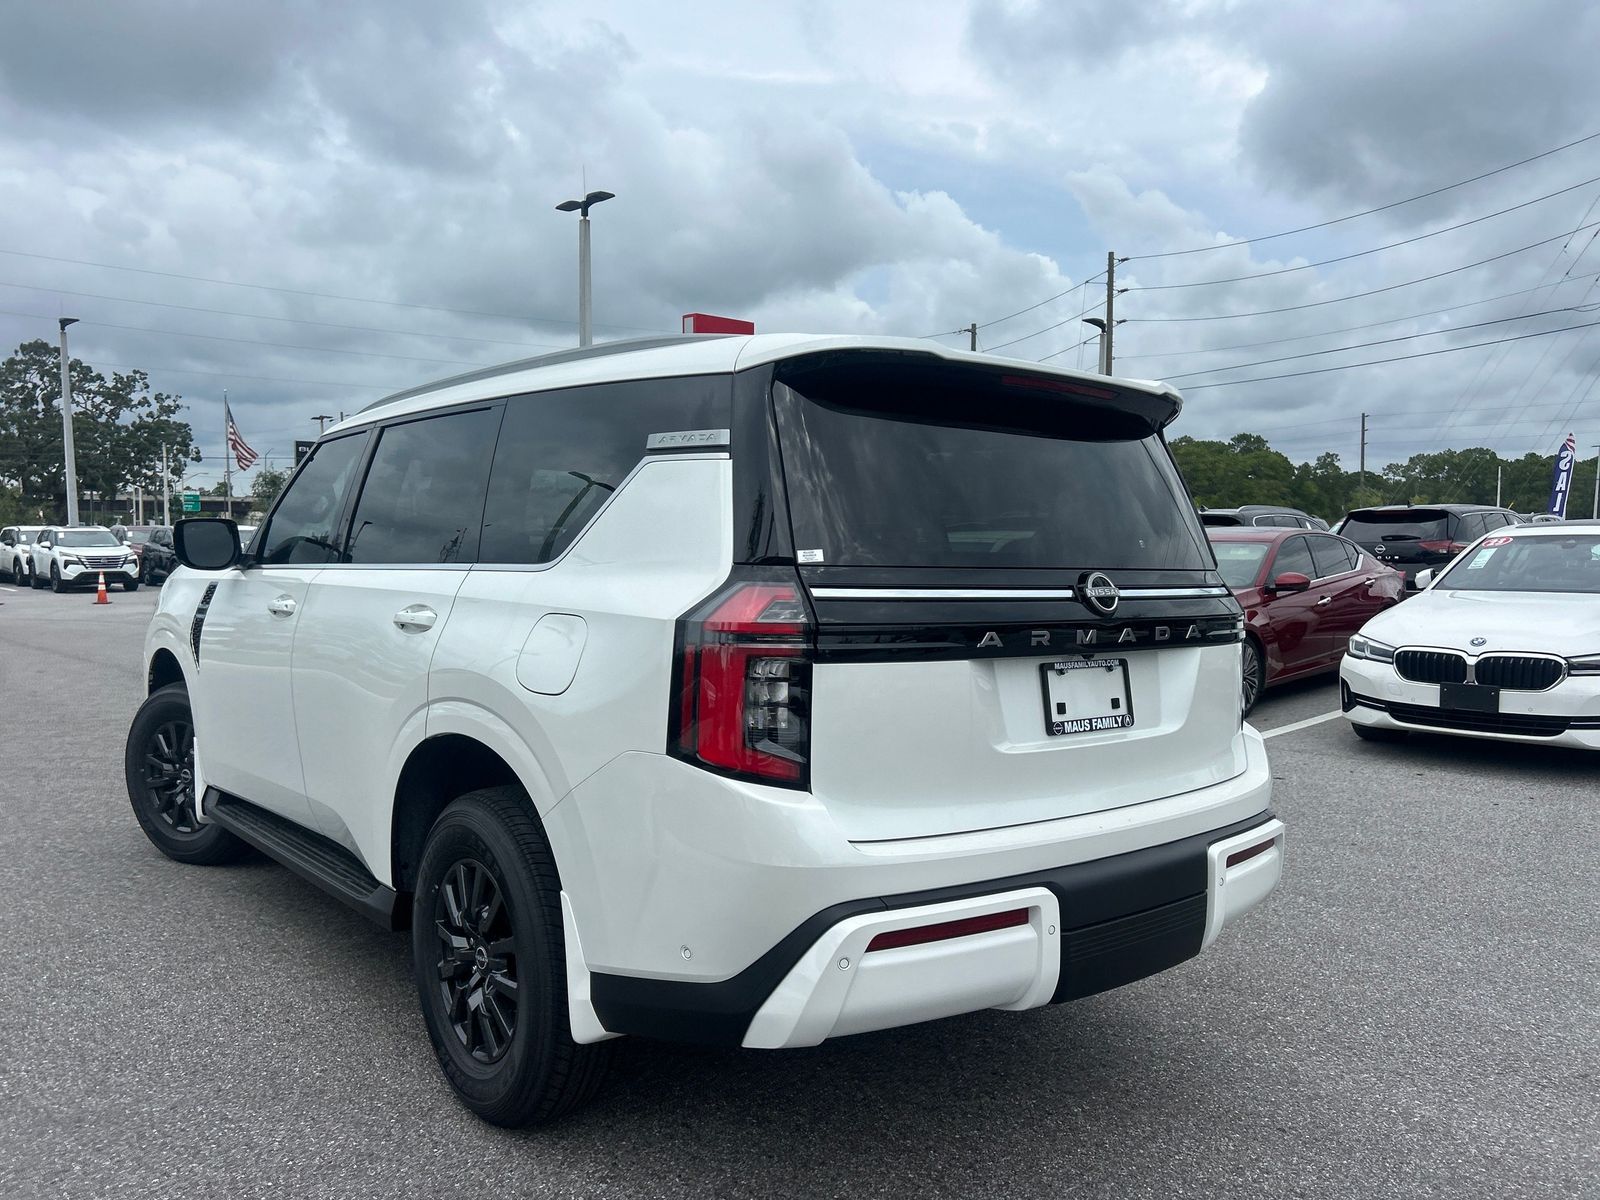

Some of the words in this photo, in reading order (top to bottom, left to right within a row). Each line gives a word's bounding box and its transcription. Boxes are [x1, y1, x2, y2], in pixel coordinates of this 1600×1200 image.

[1086, 587, 1120, 597] NISSAN
[976, 624, 1201, 648] ARMADA
[1054, 659, 1120, 670] MAUSFAMILYAUTO.COM
[1064, 719, 1090, 733] MAUS
[1091, 715, 1123, 730] FAMILY
